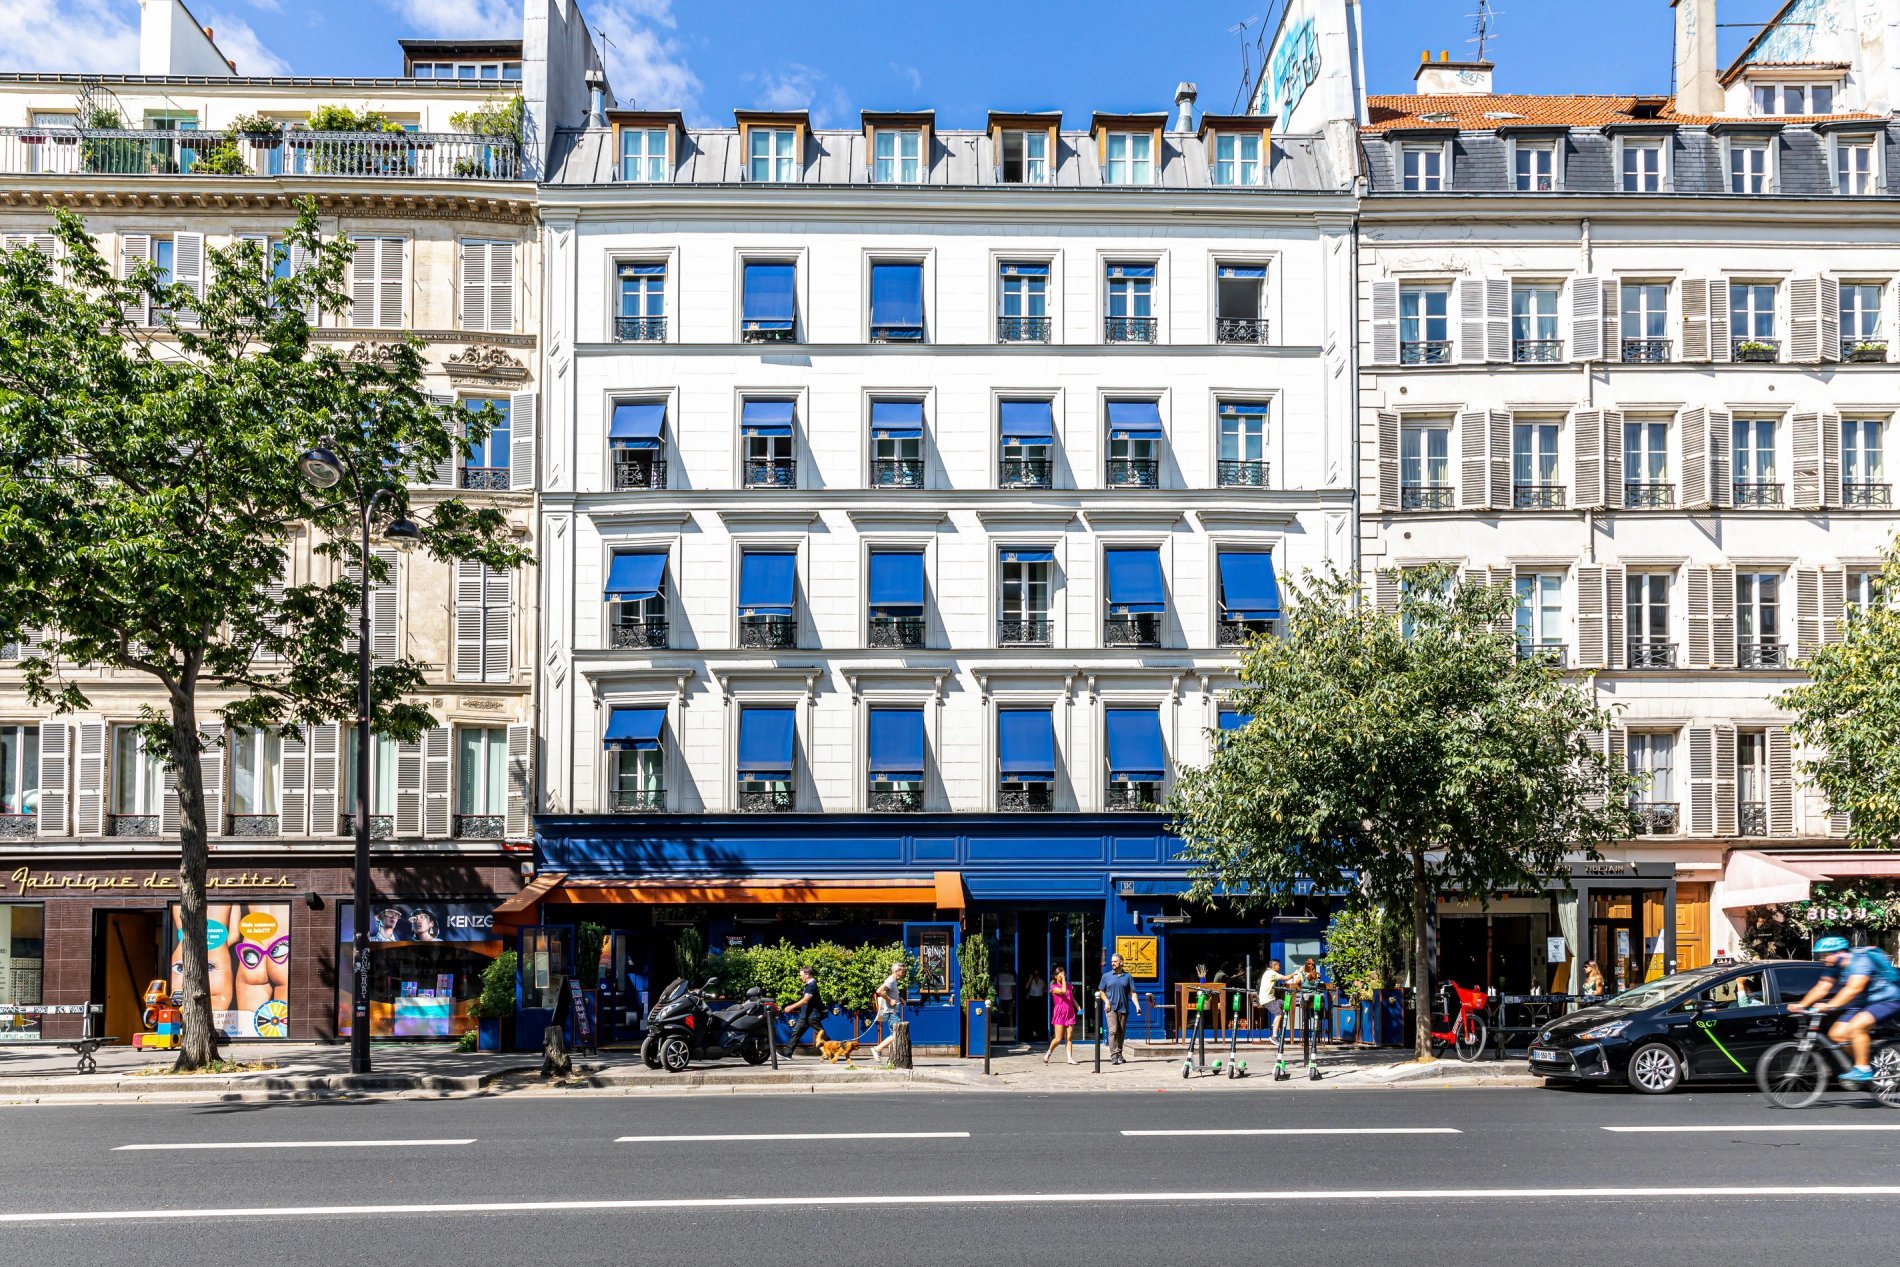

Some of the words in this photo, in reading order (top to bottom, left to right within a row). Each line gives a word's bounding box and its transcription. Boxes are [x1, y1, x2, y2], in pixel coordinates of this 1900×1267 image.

[12, 867, 138, 895] Fabrique
[143, 872, 177, 887] de
[205, 873, 295, 887] nettes
[923, 945, 946, 958] DRINKS
